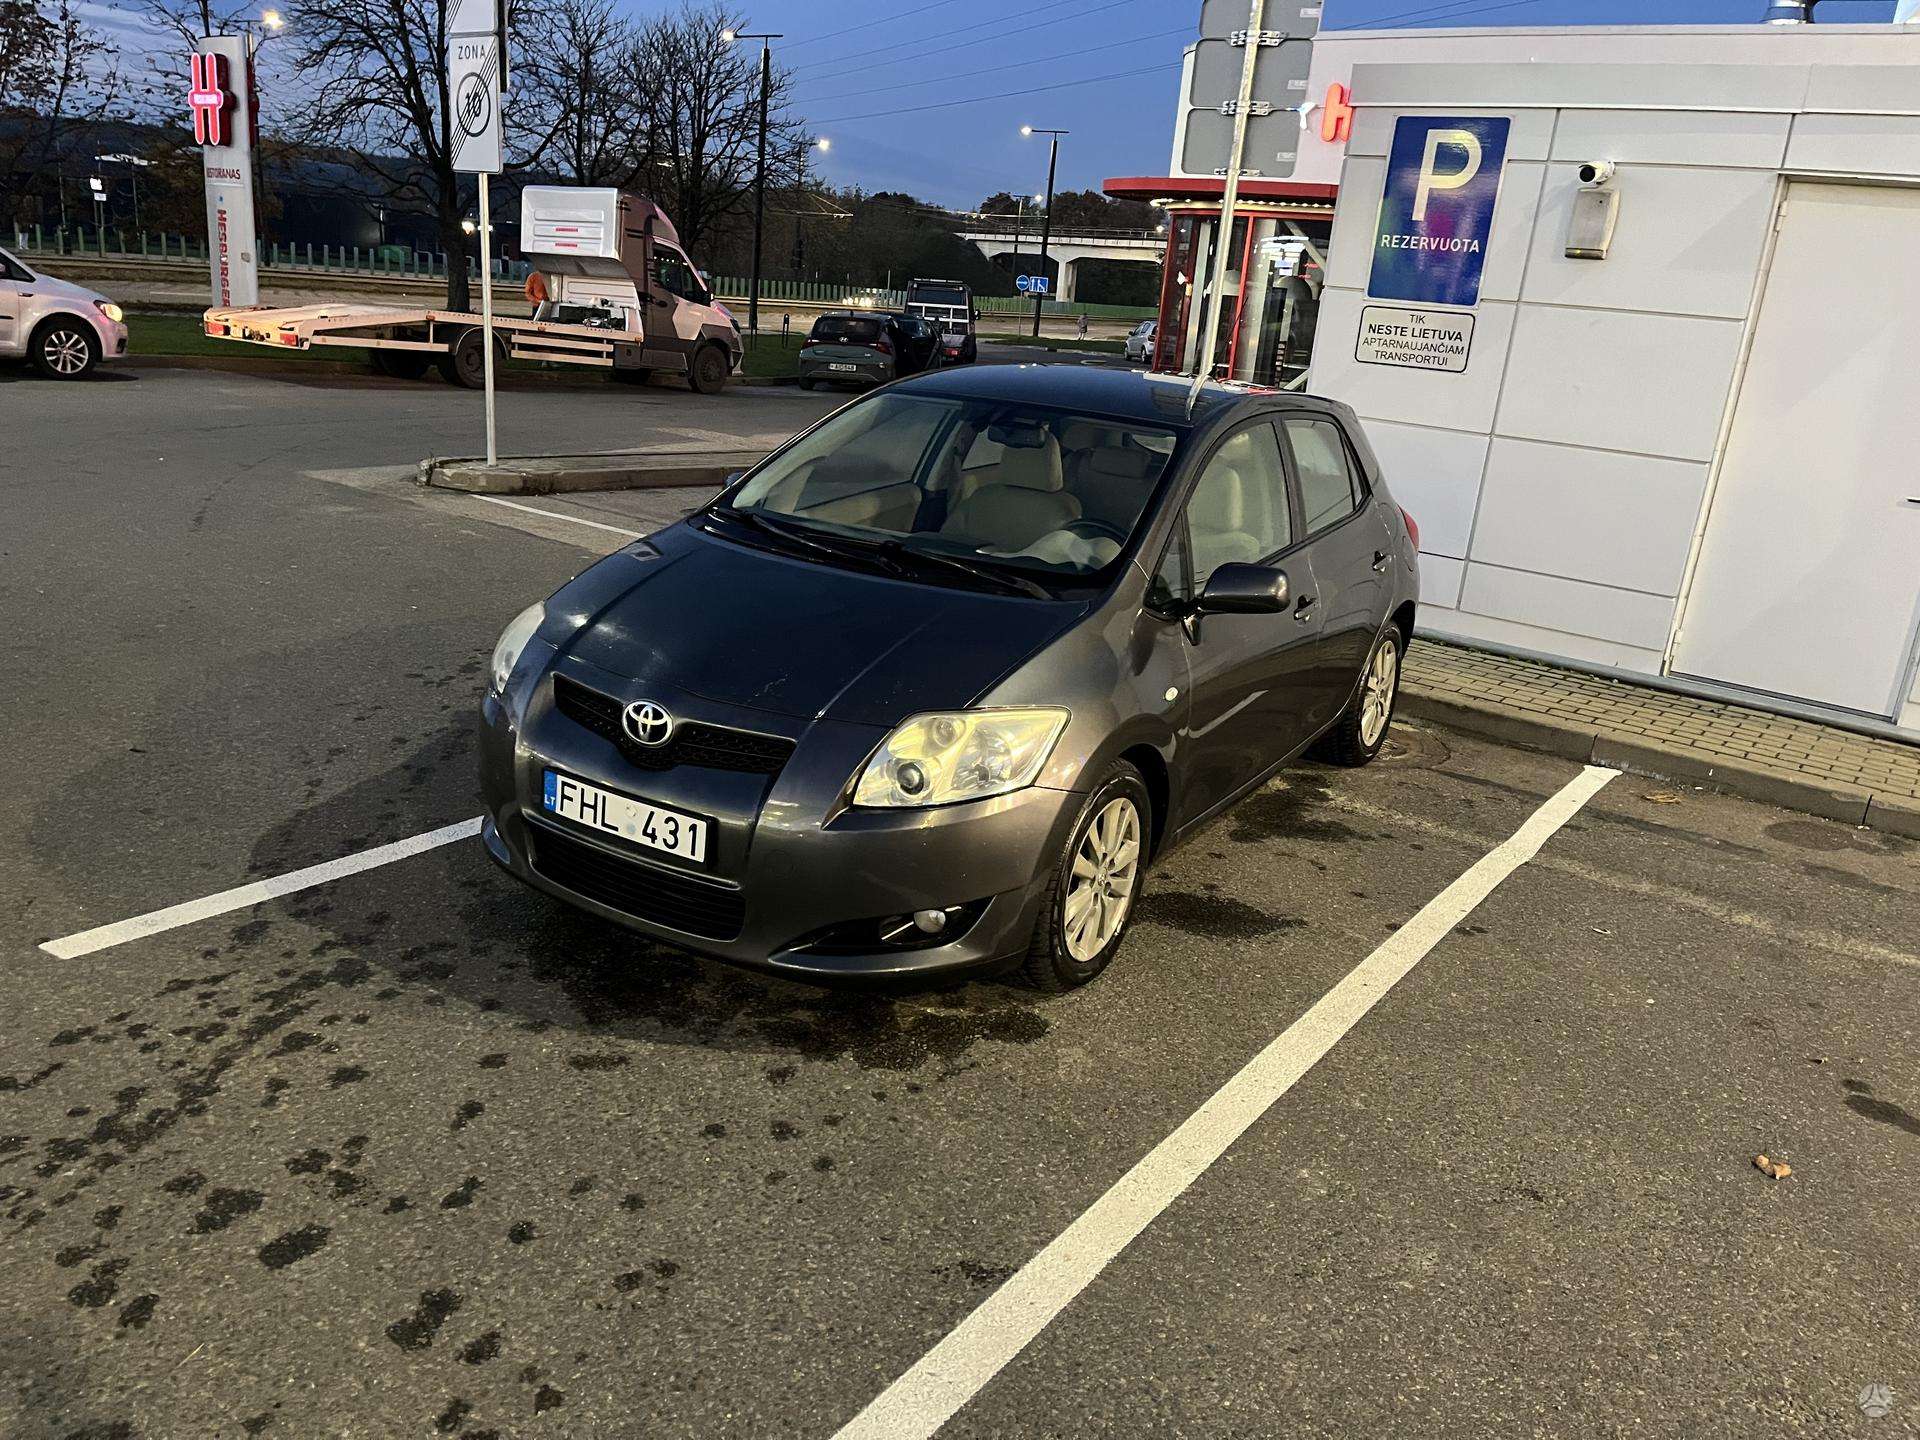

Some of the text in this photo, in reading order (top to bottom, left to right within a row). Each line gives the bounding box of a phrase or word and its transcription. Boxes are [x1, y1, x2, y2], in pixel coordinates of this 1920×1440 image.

[458, 44, 487, 60] ZONA
[1411, 128, 1482, 222] P
[1381, 234, 1480, 253] REZERVUOTA
[1409, 314, 1426, 324] TIK
[1368, 323, 1463, 342] NESTE LIETUVA
[1362, 336, 1465, 355] APTARNAUJANČIAM
[1374, 349, 1448, 366] TRANSPORTUI
[544, 793, 556, 807] LT
[559, 780, 698, 857] FHL 431
